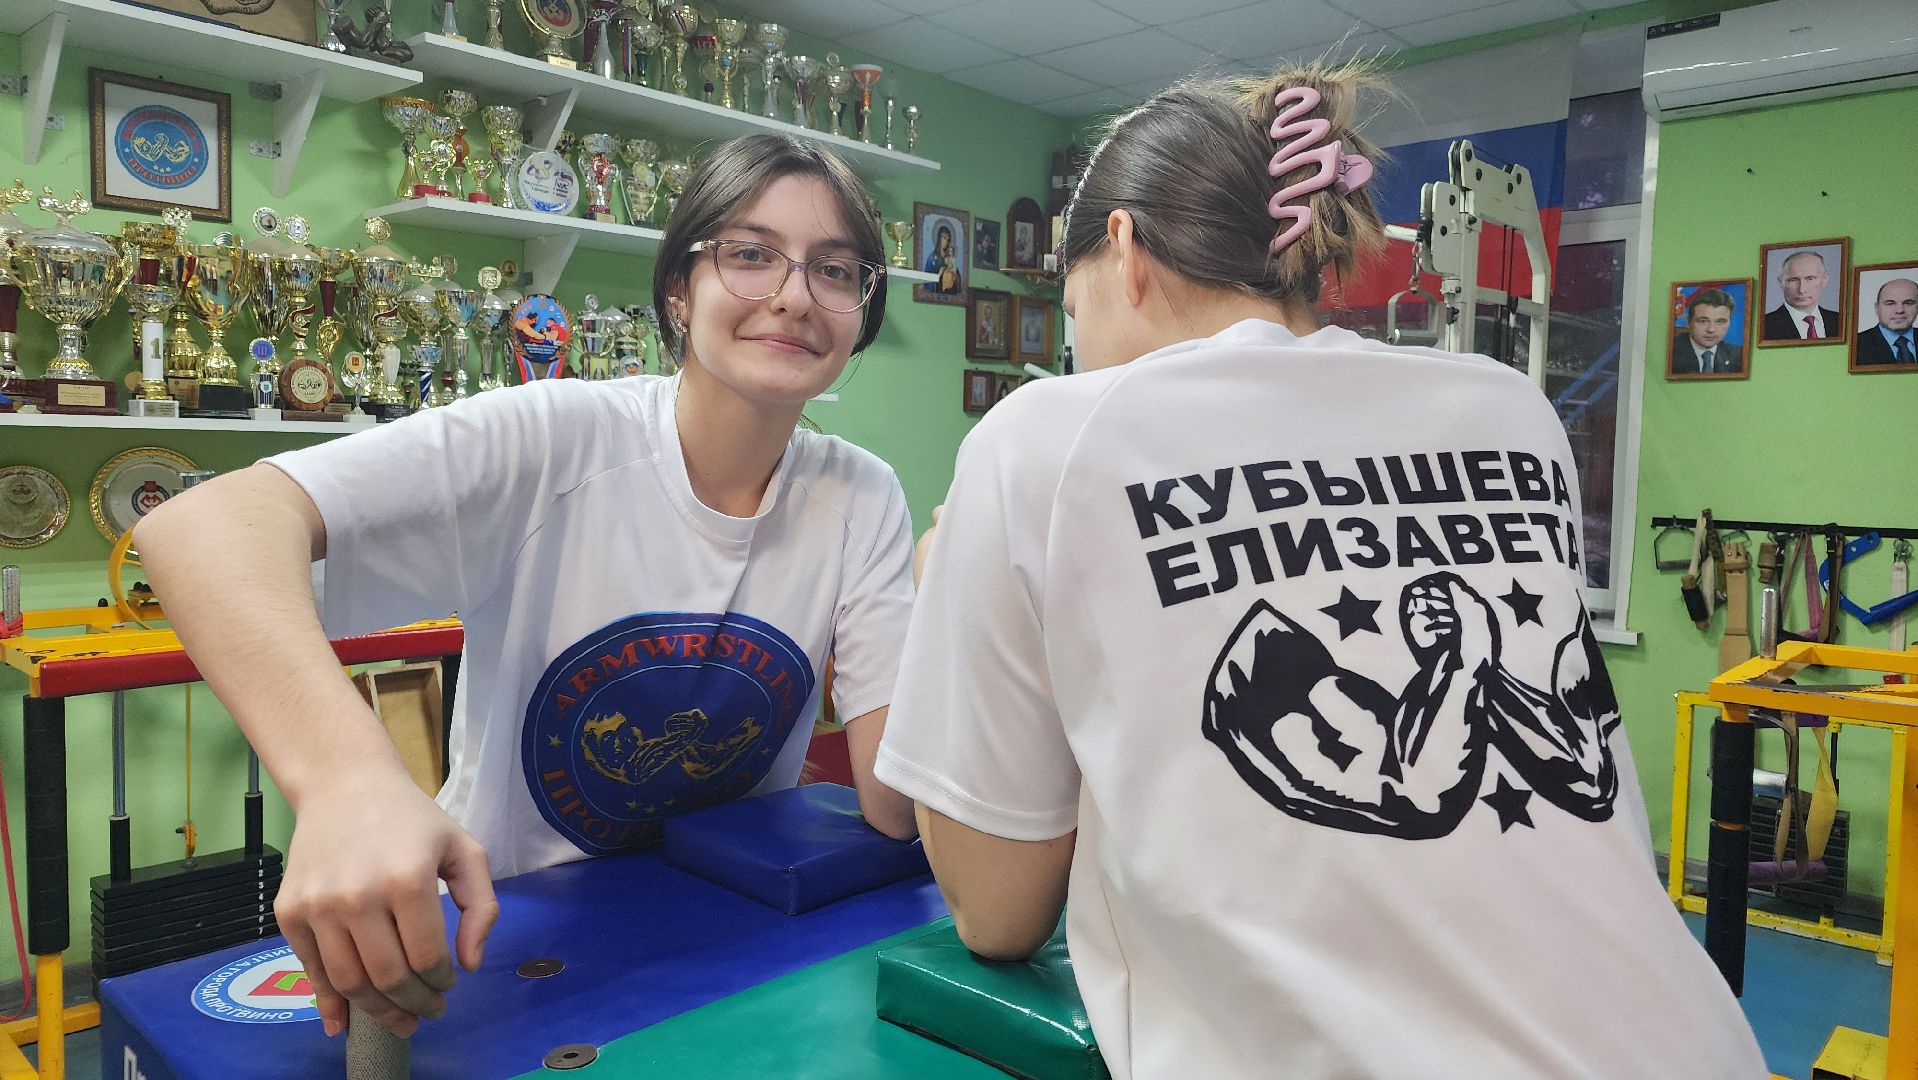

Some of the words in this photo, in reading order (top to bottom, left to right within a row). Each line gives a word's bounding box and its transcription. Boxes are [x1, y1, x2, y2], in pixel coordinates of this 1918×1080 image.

[150, 338, 161, 359] 1
[1125, 451, 1572, 539] КУБЫШЕВА
[1146, 512, 1582, 607] ЕЛИЗАВЕТА
[258, 859, 263, 867] 1
[258, 869, 264, 877] 2
[258, 881, 264, 889] 3
[258, 893, 264, 901] 4
[259, 904, 265, 912] 5
[258, 926, 263, 935] 7
[205, 997, 294, 1020] ПРОТВИНО
